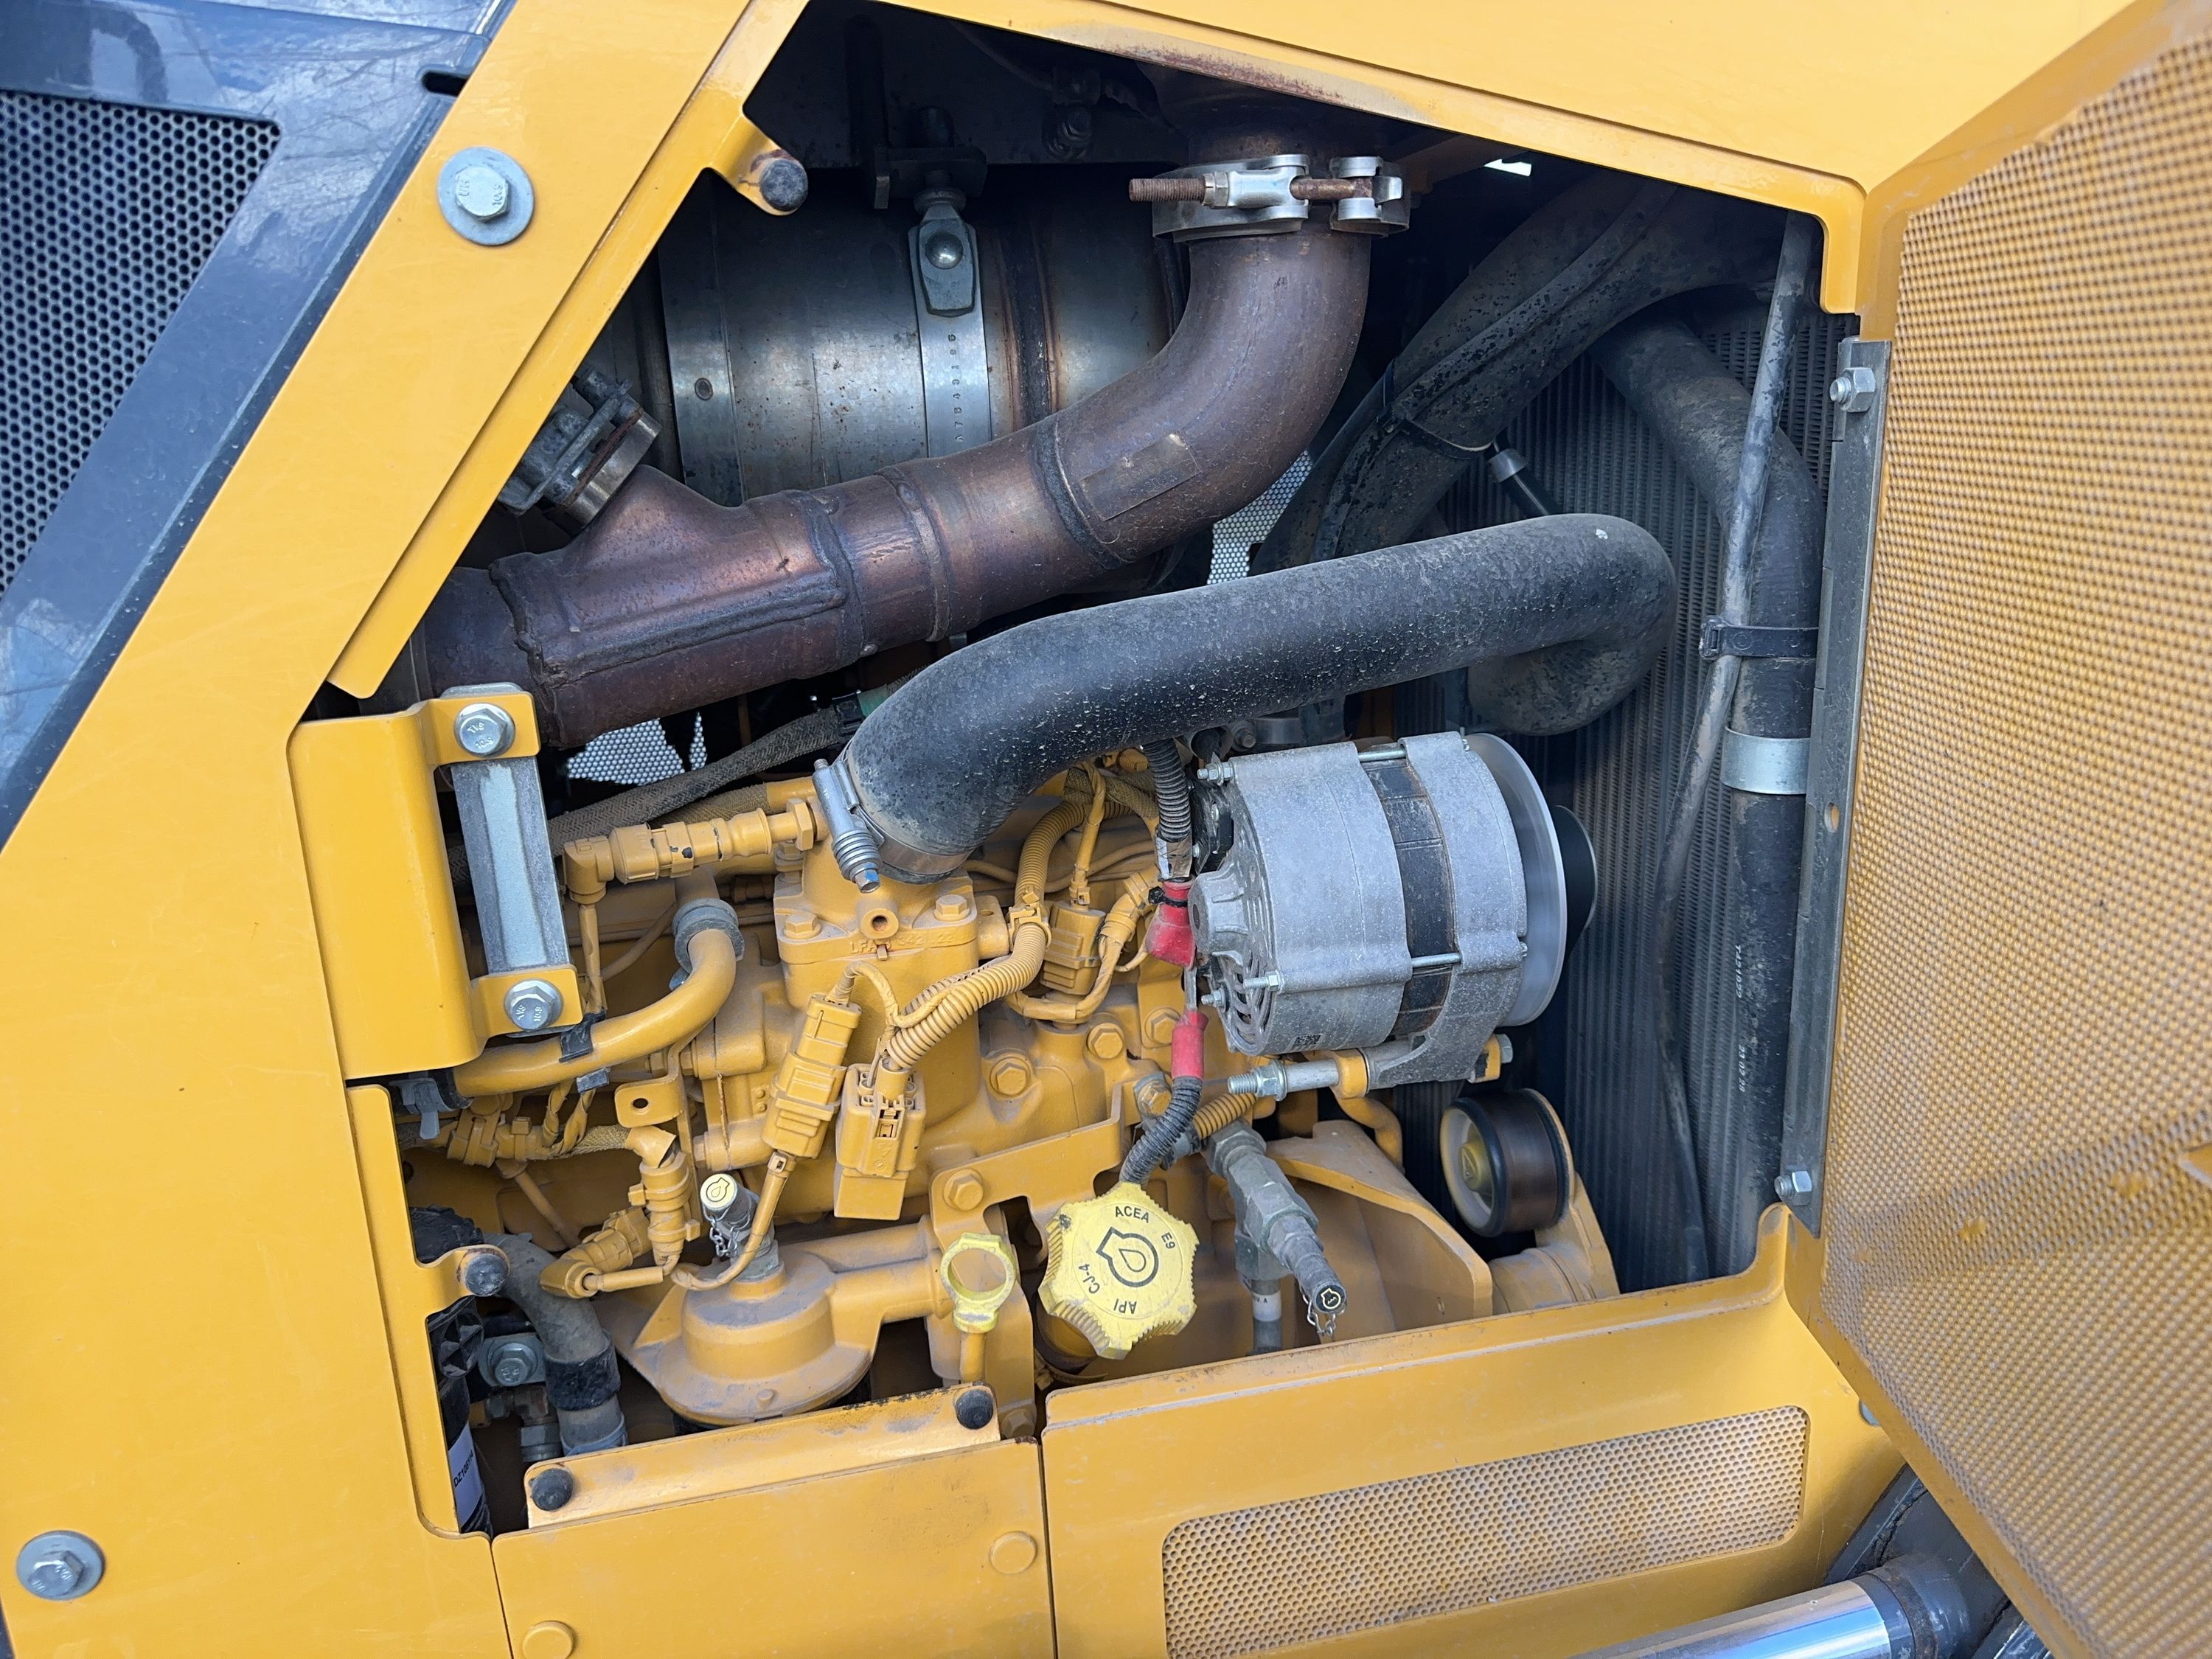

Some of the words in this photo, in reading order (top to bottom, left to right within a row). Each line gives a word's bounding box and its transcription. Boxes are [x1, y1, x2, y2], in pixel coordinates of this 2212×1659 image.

[1115, 1206, 1150, 1223] ACEA
[1161, 1231, 1176, 1250] E9
[1078, 1263, 1101, 1295] CJ-4
[1113, 1298, 1137, 1314] API
